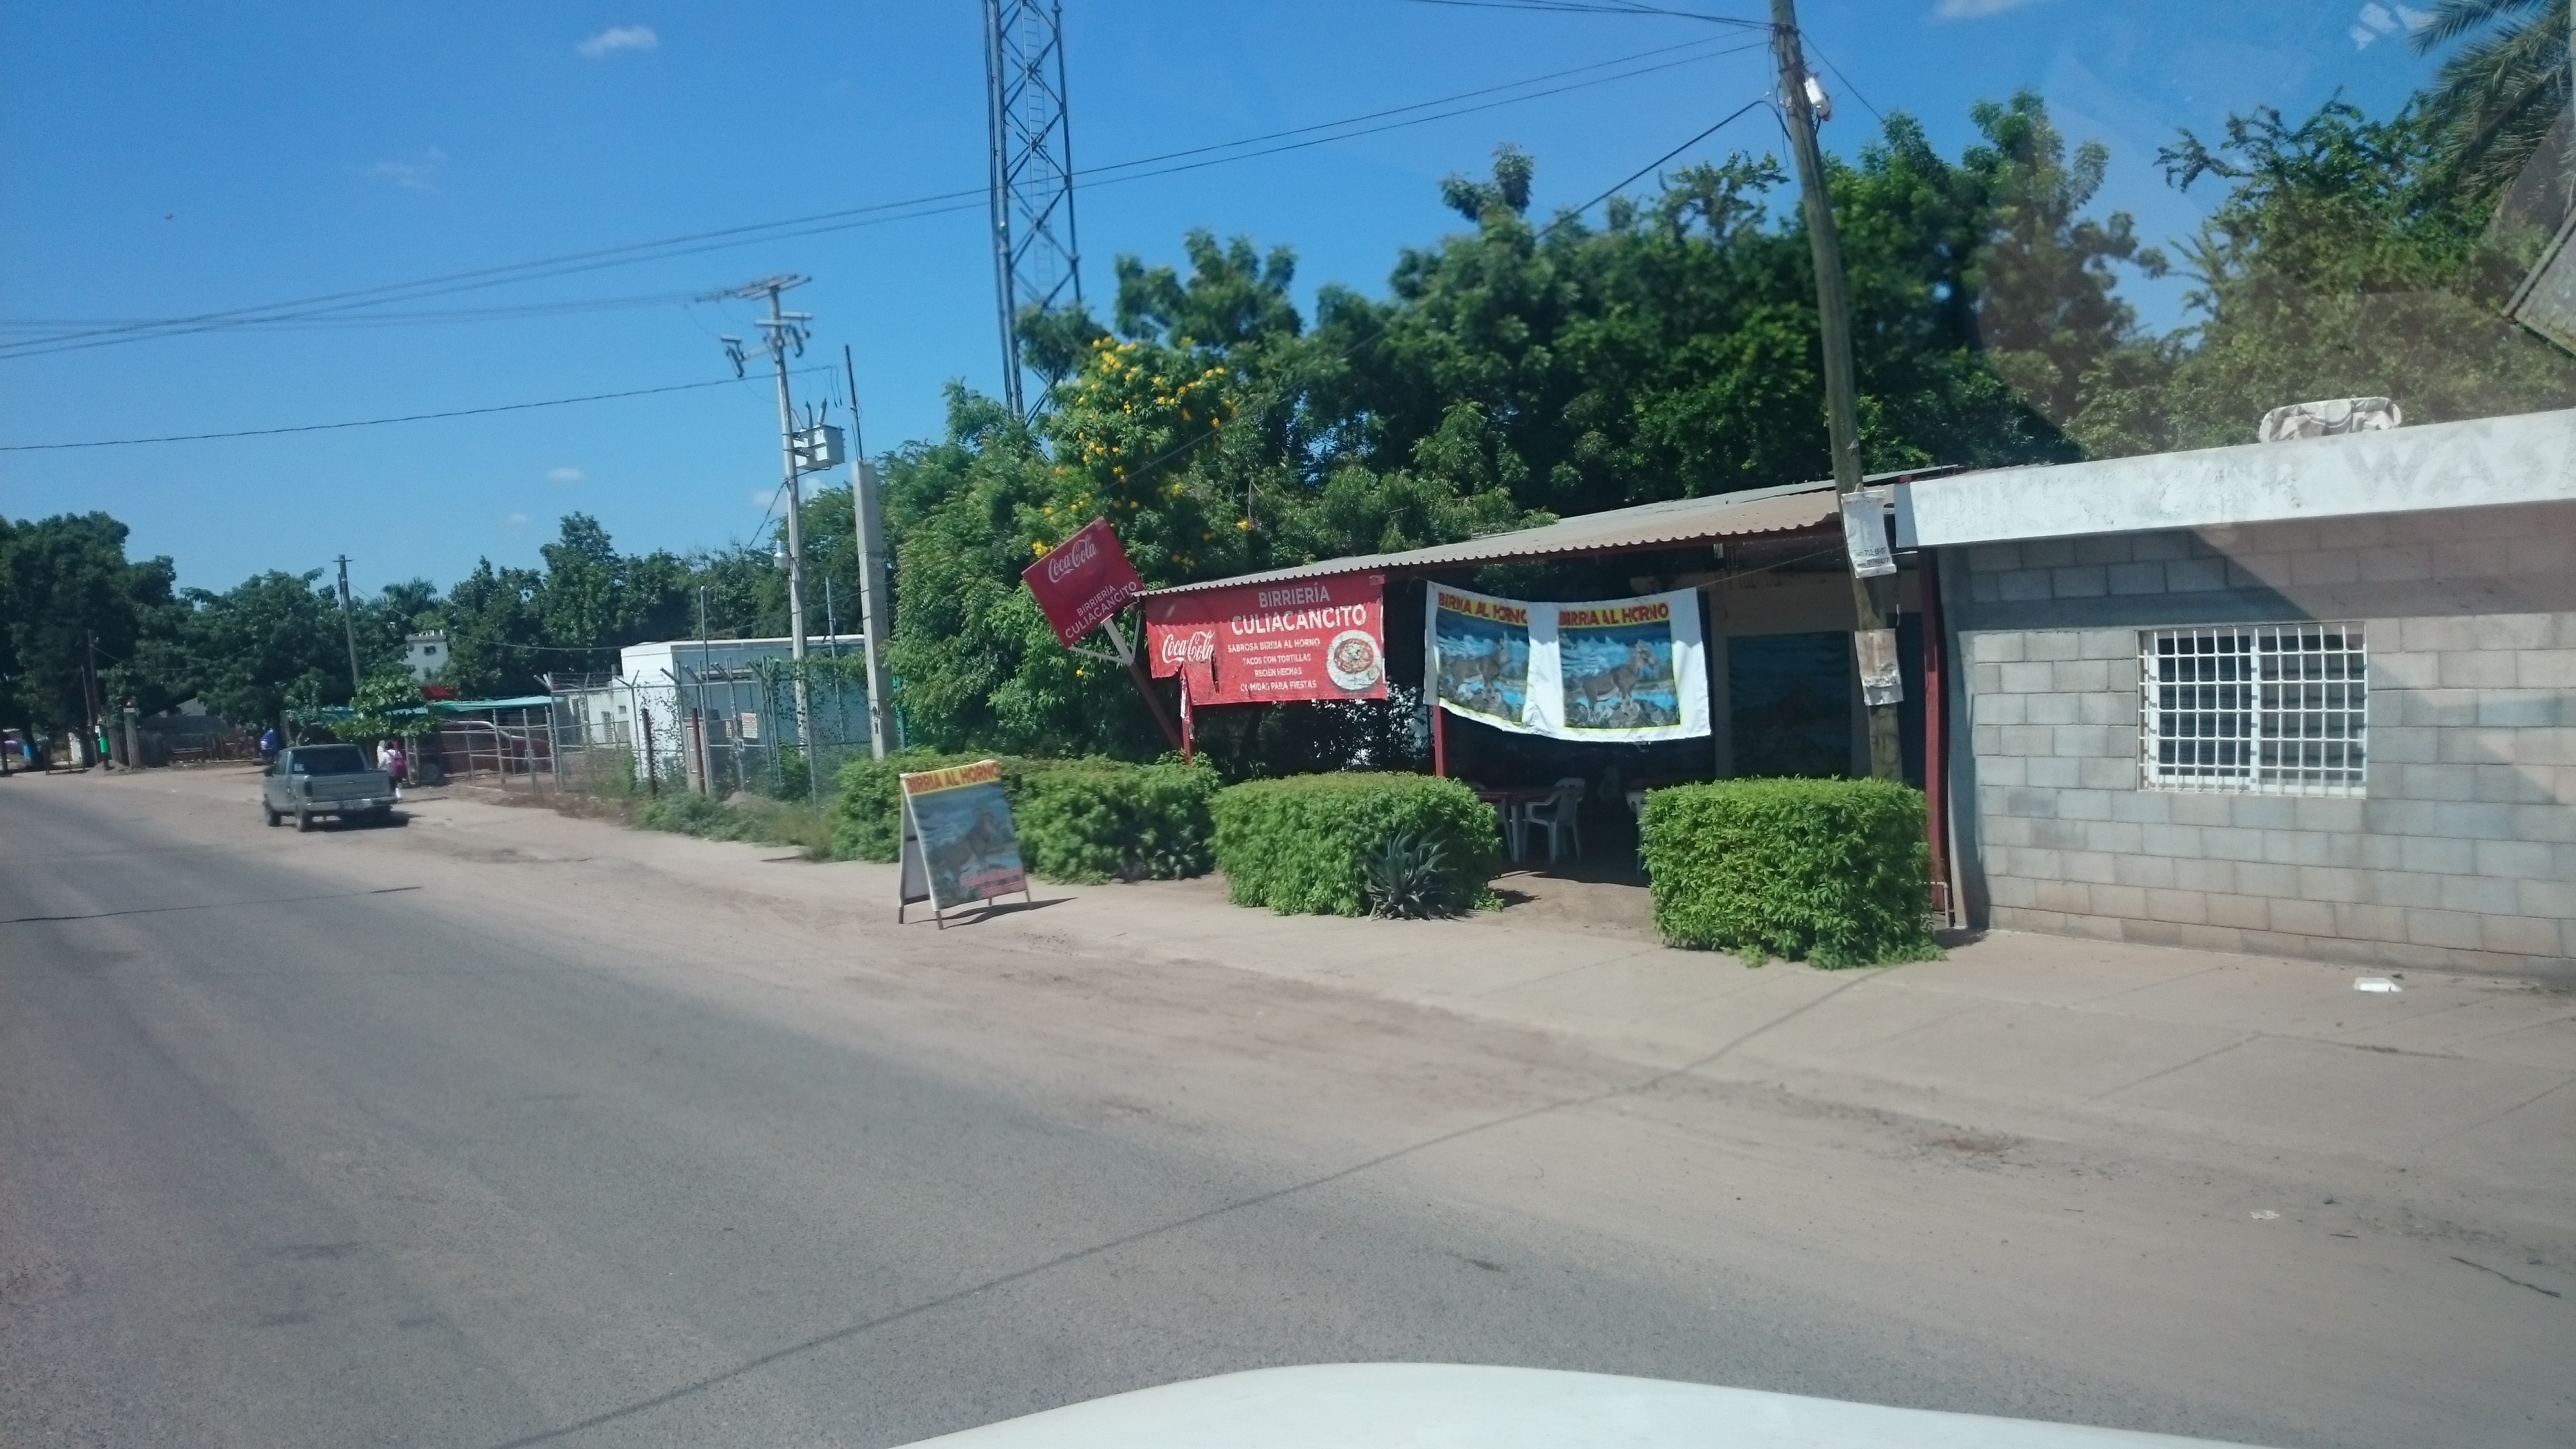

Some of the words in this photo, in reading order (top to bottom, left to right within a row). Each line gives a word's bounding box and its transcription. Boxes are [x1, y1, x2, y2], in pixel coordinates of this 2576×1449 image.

[1077, 585, 1116, 616] BIRRIERÍA
[1258, 582, 1330, 608] BIRRIERÍA
[1438, 592, 1472, 614] BIRRIA
[1477, 604, 1490, 618] AL
[1065, 581, 1137, 639] CULIACANCITO
[1230, 603, 1367, 636] CULIACANCITO
[1558, 610, 1600, 626] BIRRIA
[1603, 611, 1619, 625] AL
[1621, 602, 1669, 624] HORNO
[1227, 642, 1259, 653] SABROSA
[1260, 641, 1282, 651] BIRRIA
[1283, 639, 1293, 649] AL
[1294, 638, 1320, 648] HORNO
[1242, 656, 1263, 665] TACOS
[1263, 656, 1277, 664] CON
[1277, 653, 1311, 663] TORTILLAS
[1277, 667, 1302, 676] HECHAS
[1271, 681, 1289, 690] PARA
[1289, 680, 1318, 690] FIESTAS
[905, 773, 943, 794] BIRRIA
[945, 769, 960, 786] AL
[959, 761, 999, 784] HORNO
